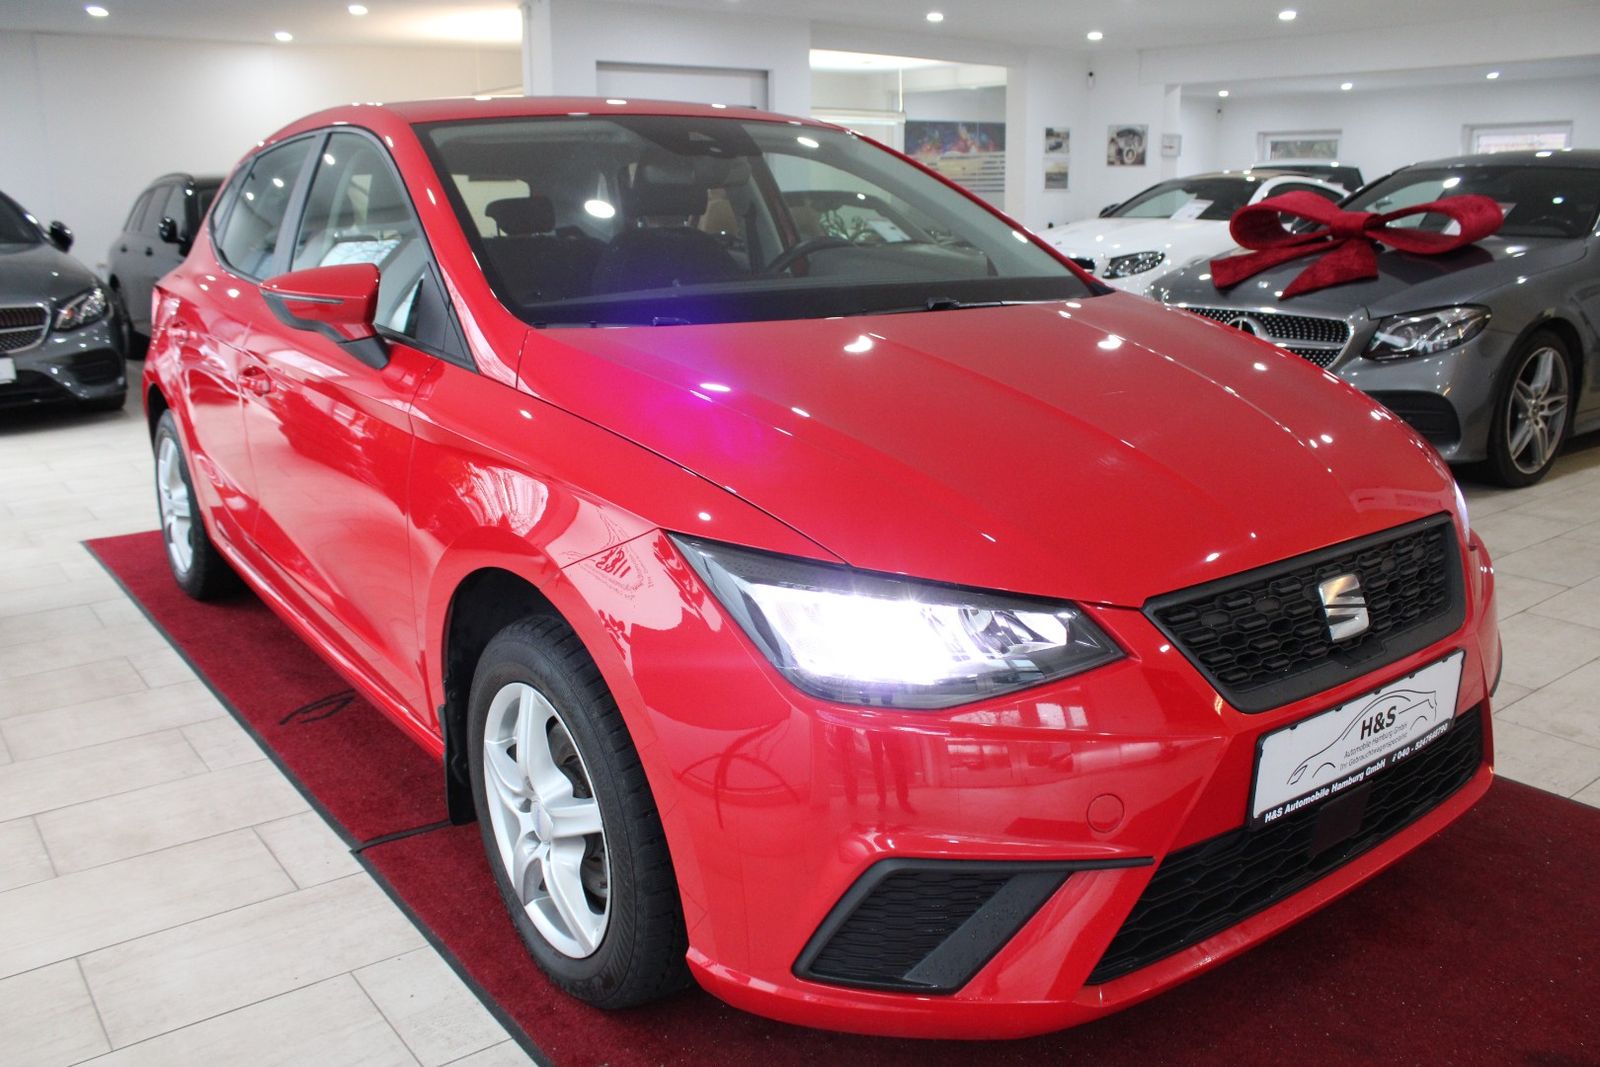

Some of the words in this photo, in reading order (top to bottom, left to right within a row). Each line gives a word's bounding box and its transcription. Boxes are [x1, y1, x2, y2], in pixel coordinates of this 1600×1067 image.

[1360, 705, 1397, 740] H&S
[1344, 741, 1371, 759] Automobile
[1372, 730, 1393, 745] Hamburg
[1264, 807, 1283, 823] H&S
[1284, 787, 1330, 814] Automobile
[1331, 771, 1365, 793] Hamburg
[1365, 758, 1386, 777] GmbH
